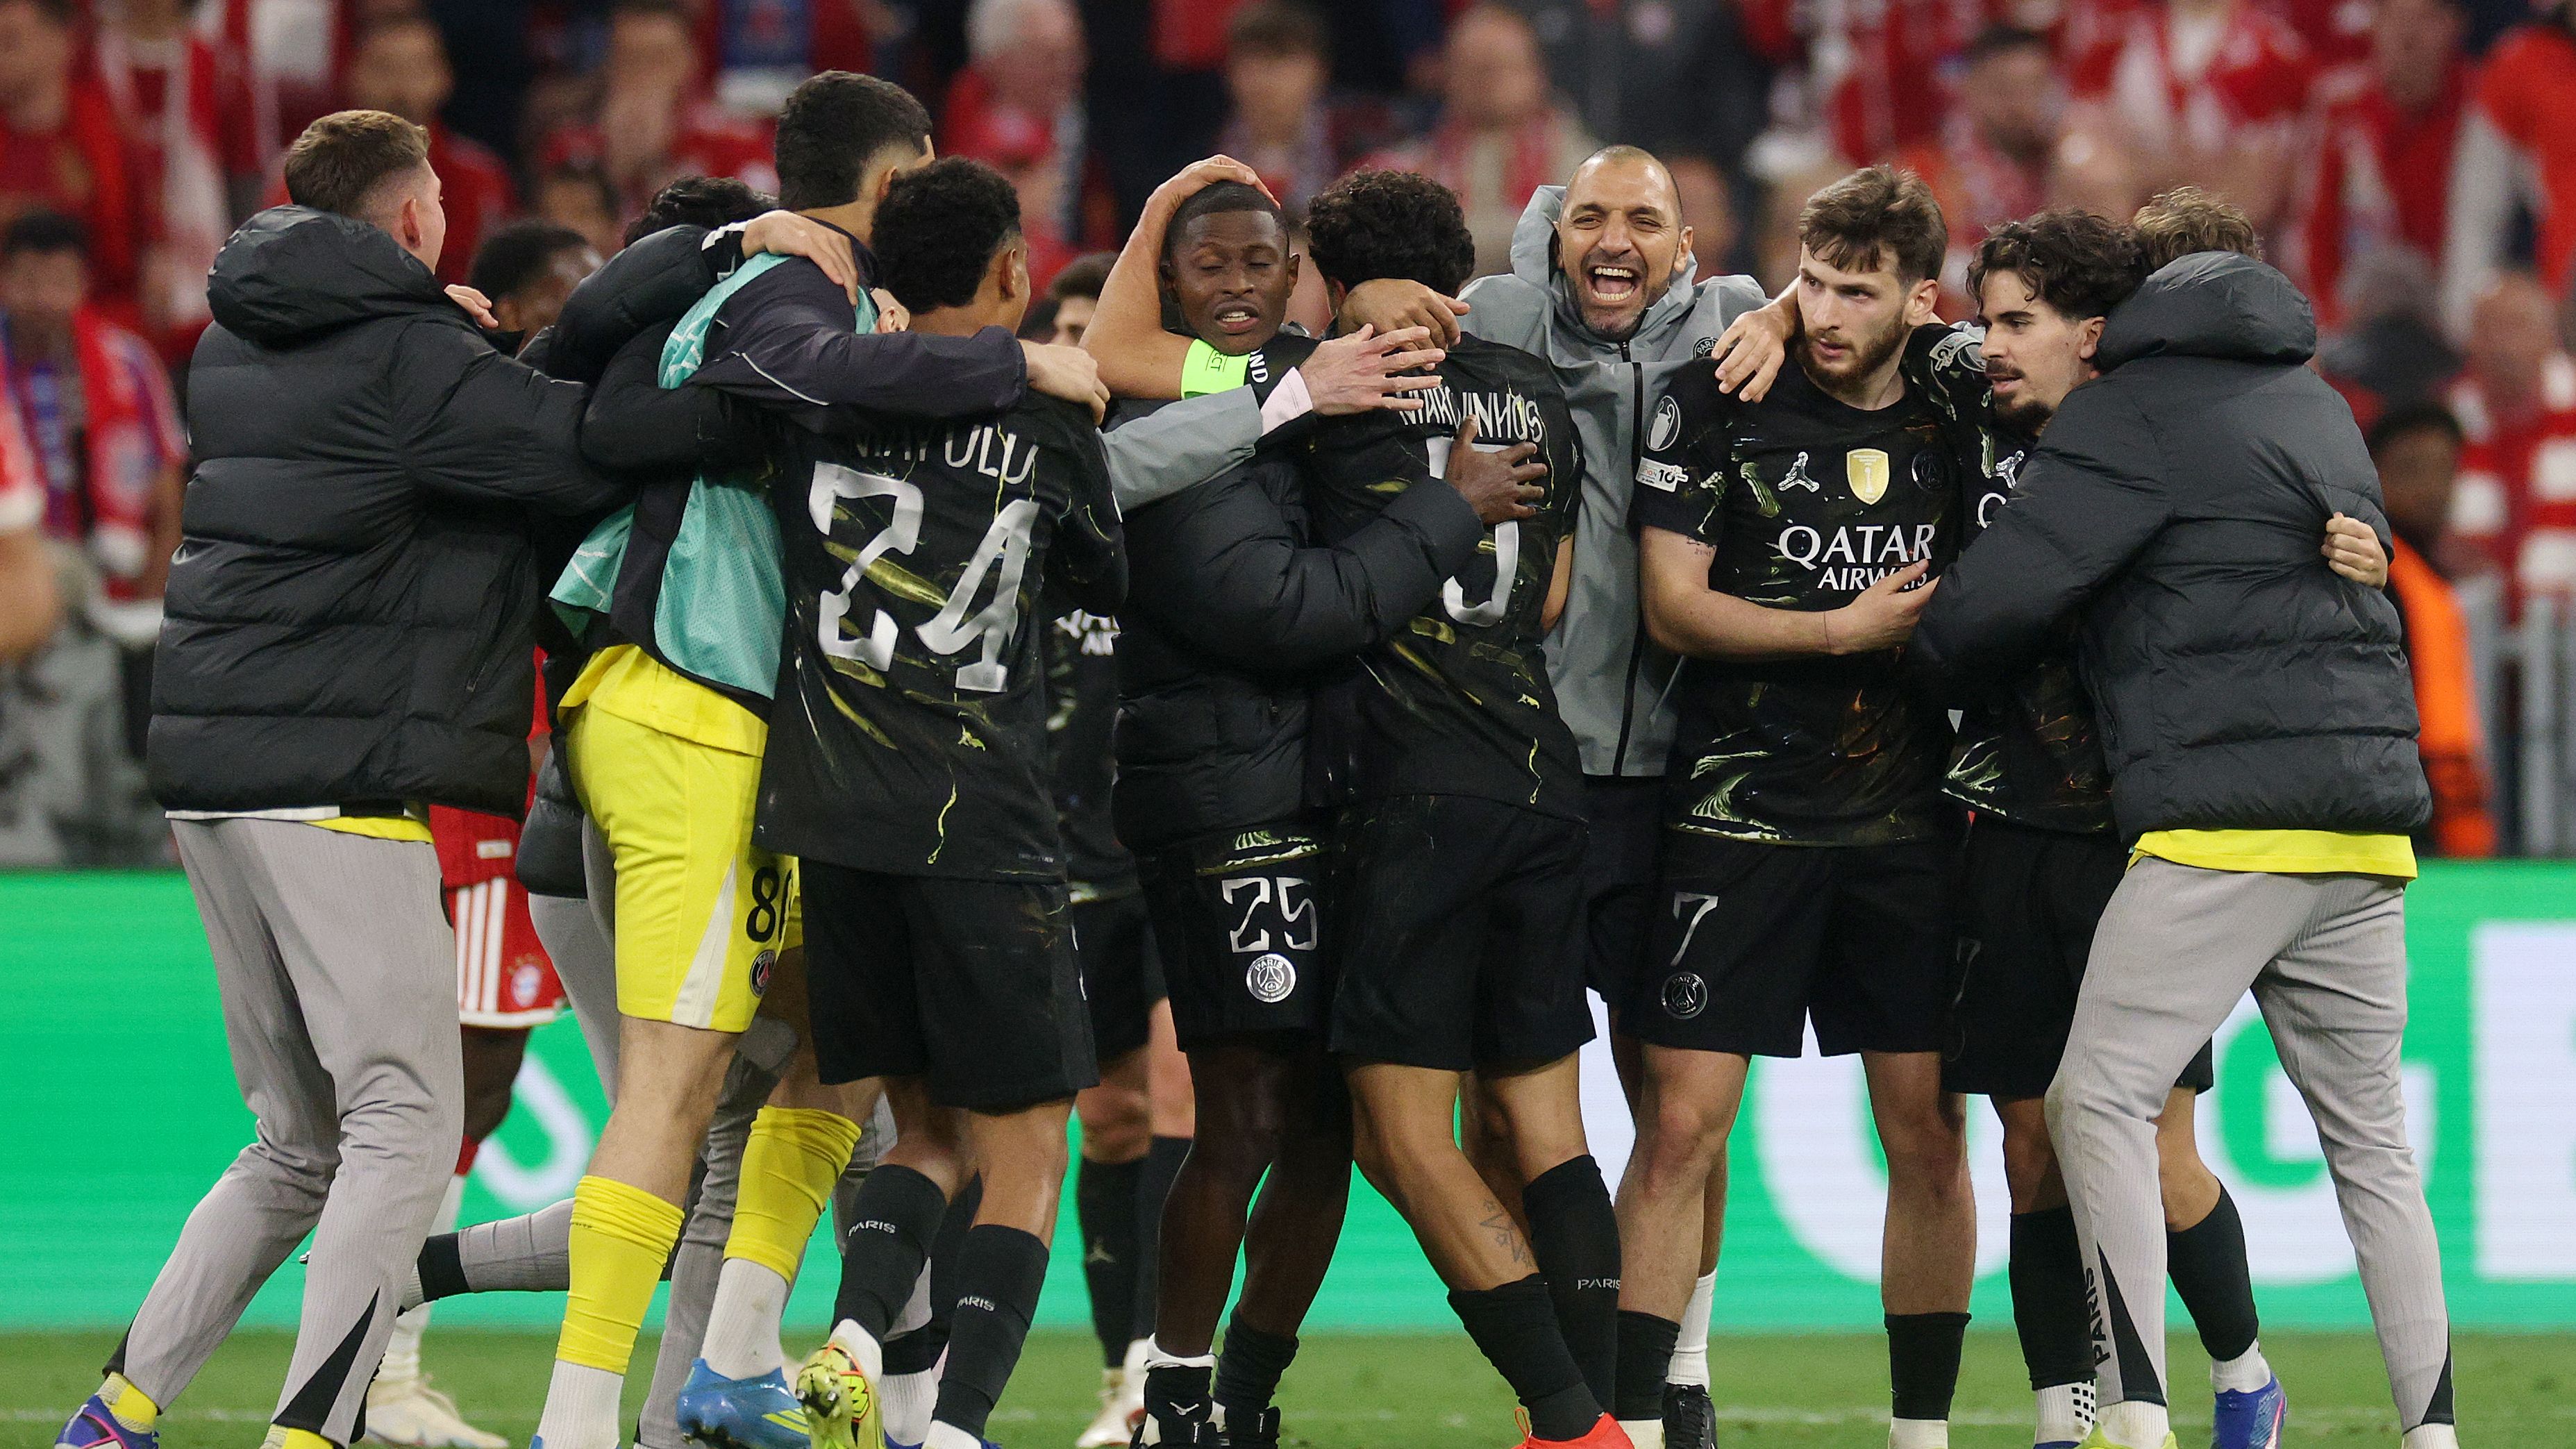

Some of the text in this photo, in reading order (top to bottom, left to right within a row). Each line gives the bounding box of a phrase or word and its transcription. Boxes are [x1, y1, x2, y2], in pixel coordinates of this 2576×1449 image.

[1697, 339, 1718, 354] PARI
[1779, 524, 1936, 571] QATAR
[808, 460, 1041, 692] 24
[1817, 566, 1927, 591] AIRWS
[1221, 877, 1317, 953] 25
[1671, 891, 1718, 966] 7
[1255, 959, 1284, 972] PARIS
[848, 1219, 896, 1237] PARIS
[1577, 1278, 1621, 1290] PARIS
[2085, 1267, 2111, 1366] PARIS
